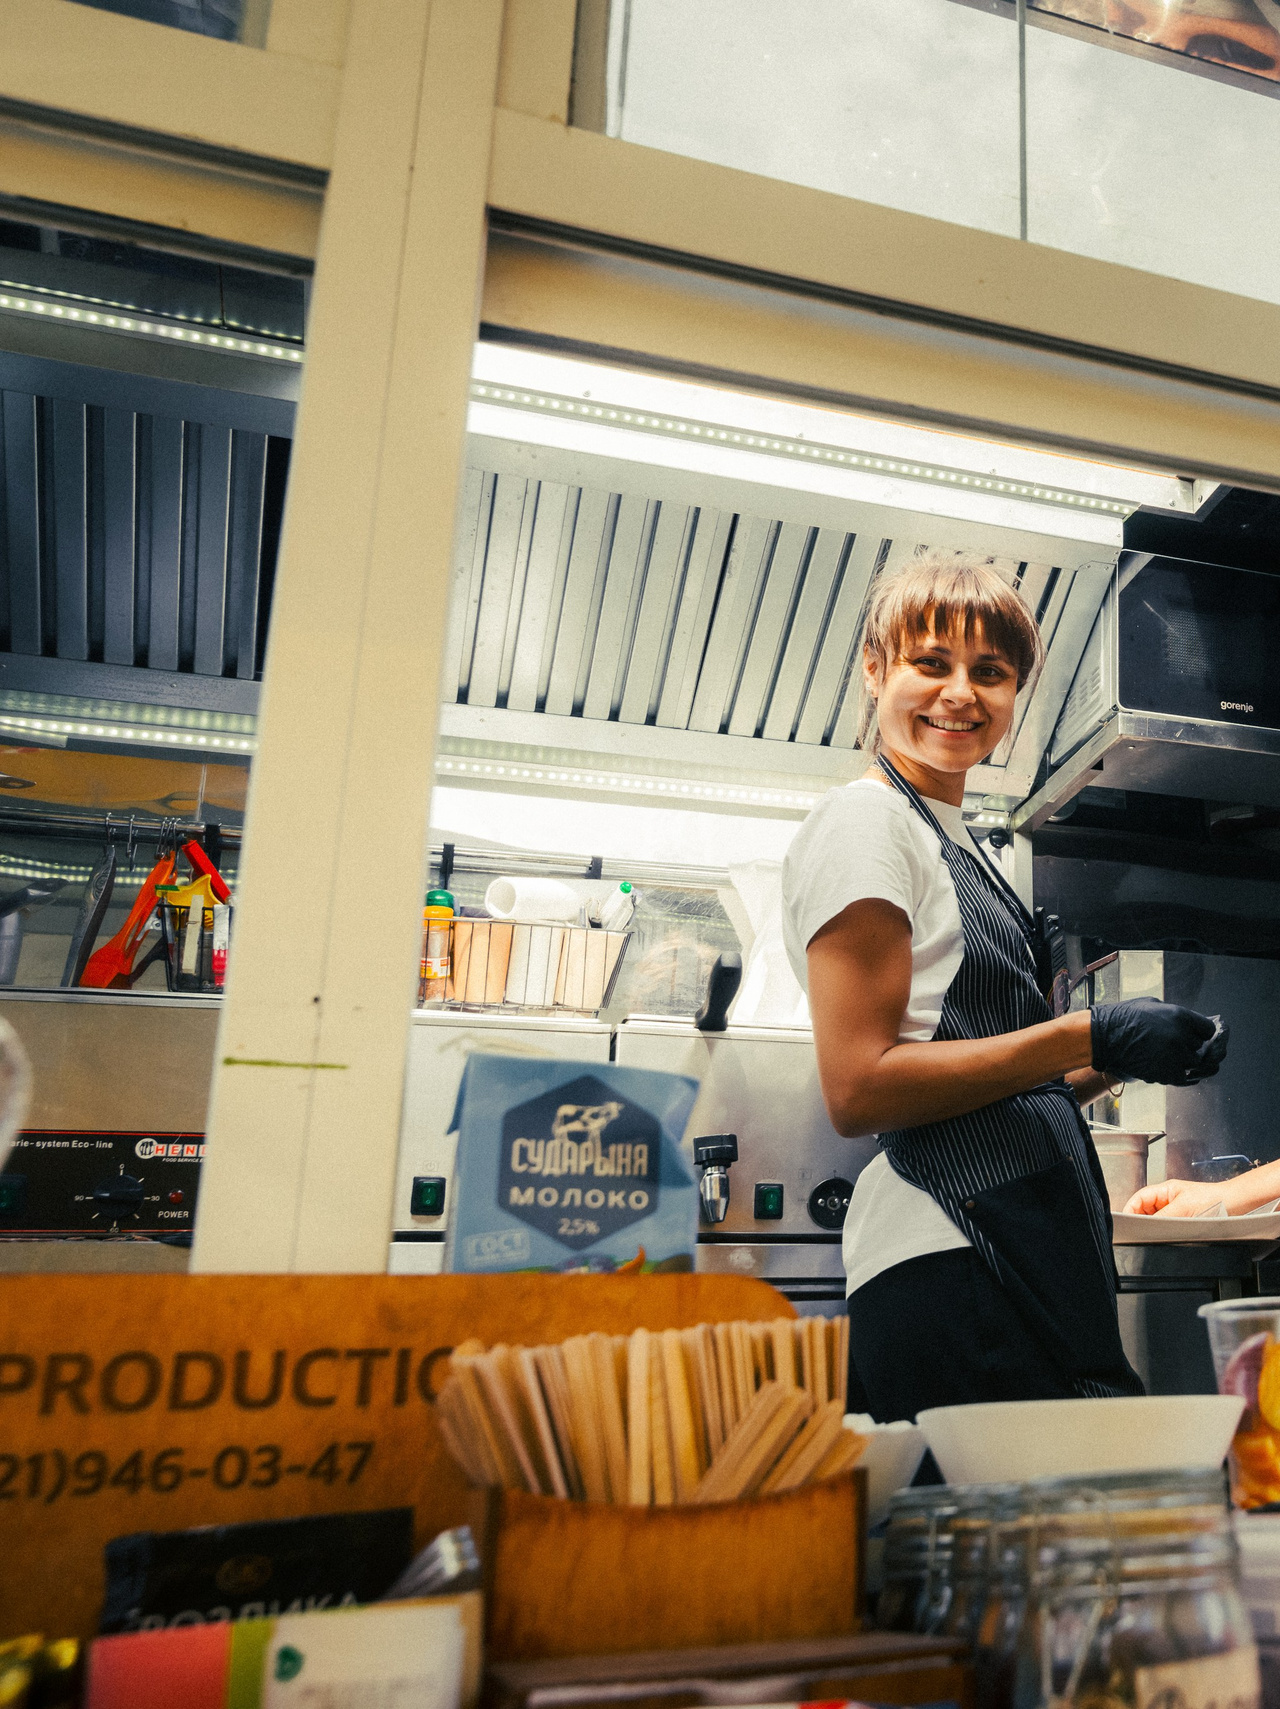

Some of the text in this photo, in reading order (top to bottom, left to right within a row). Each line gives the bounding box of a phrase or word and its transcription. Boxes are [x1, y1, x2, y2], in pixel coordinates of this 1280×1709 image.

[1220, 700, 1254, 712] gorenje
[9, 1139, 113, 1150] arie-system Eco-line
[511, 1137, 649, 1178] СУДАРЫНЯ
[508, 1185, 650, 1211] МОЛОКО
[157, 1210, 190, 1220] POWER
